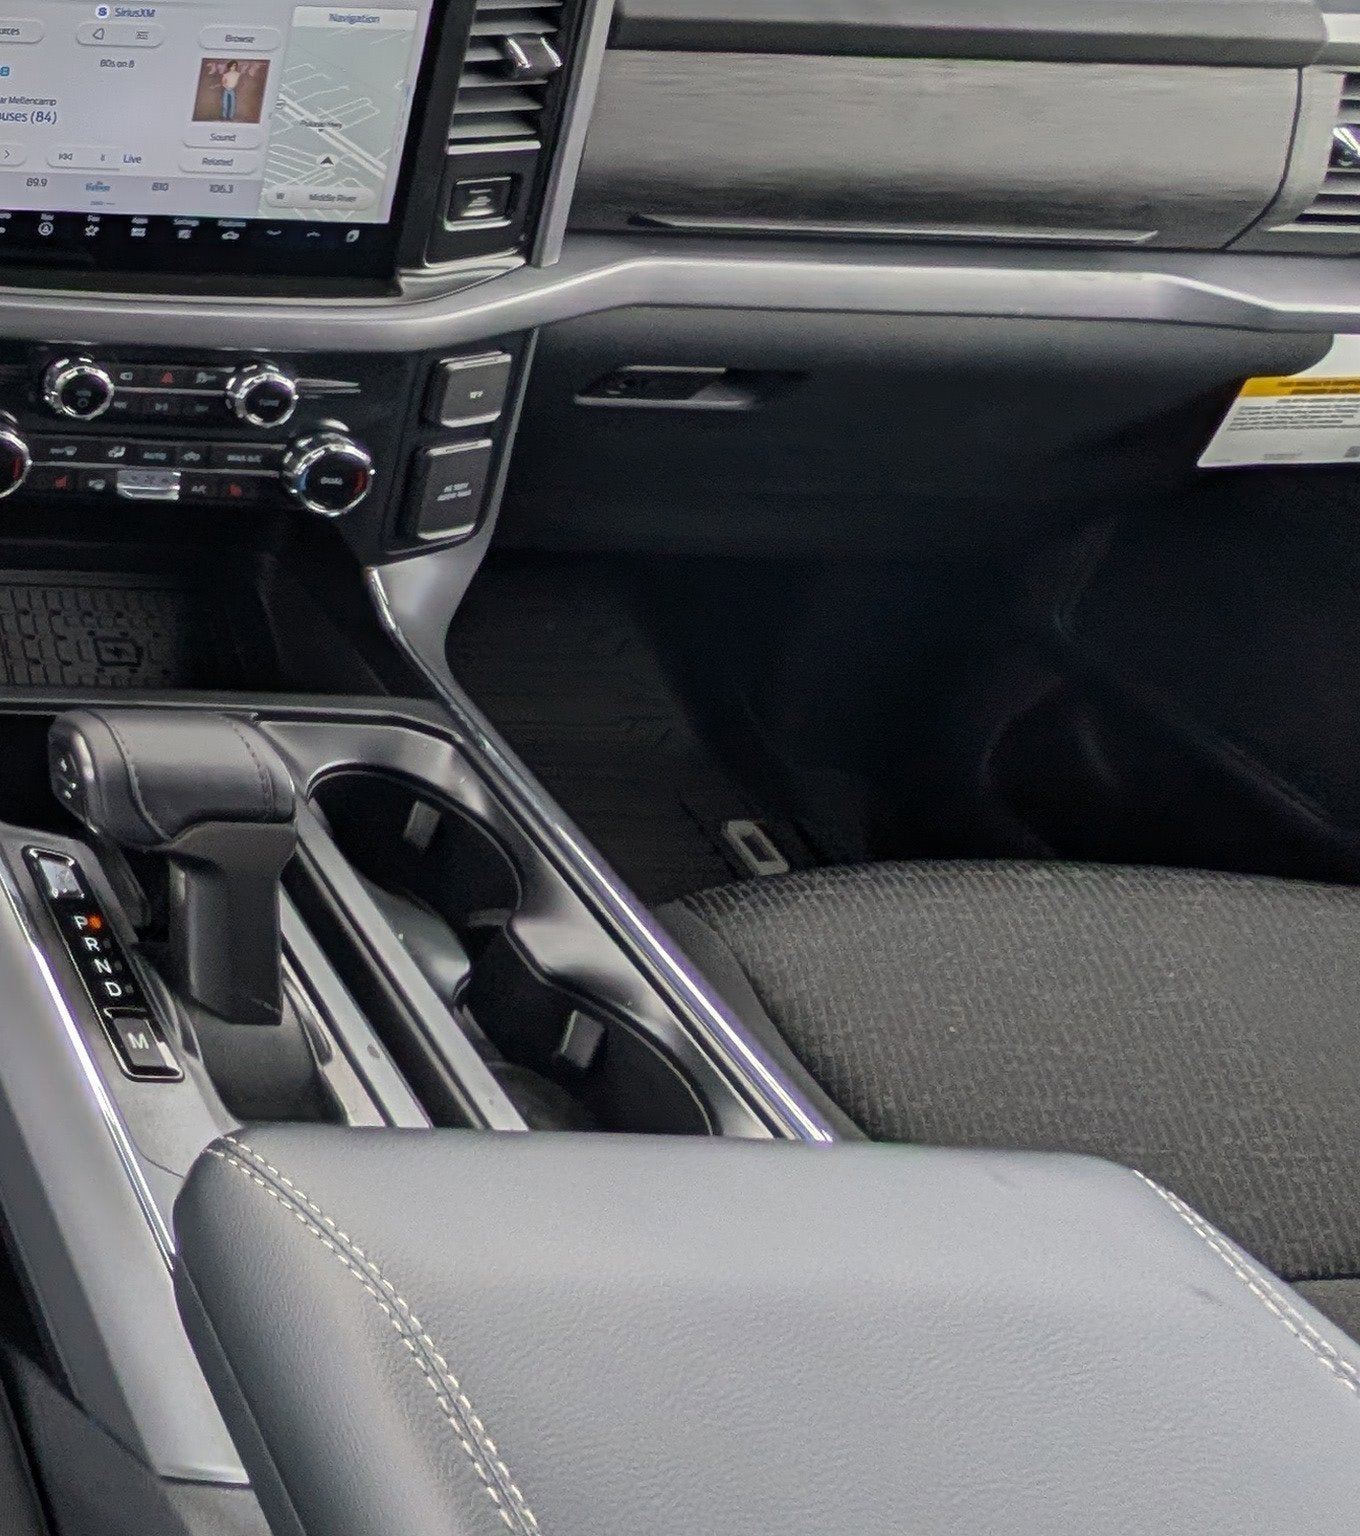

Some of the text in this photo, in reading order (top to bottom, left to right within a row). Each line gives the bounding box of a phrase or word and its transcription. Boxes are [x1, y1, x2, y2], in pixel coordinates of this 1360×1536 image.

[115, 7, 156, 18] SiriusXM
[328, 13, 381, 25] Navigation
[224, 33, 257, 44] Browse
[8, 96, 57, 107] Mellencamp
[30, 110, 58, 125] (84)
[209, 133, 237, 143] Sound
[122, 153, 142, 165] Live
[26, 177, 48, 187] 89.9
[309, 193, 357, 203] Middle River
[73, 914, 88, 931] P
[84, 937, 100, 952] R
[95, 958, 112, 974] N
[105, 981, 122, 997] D
[126, 1032, 149, 1051] M
